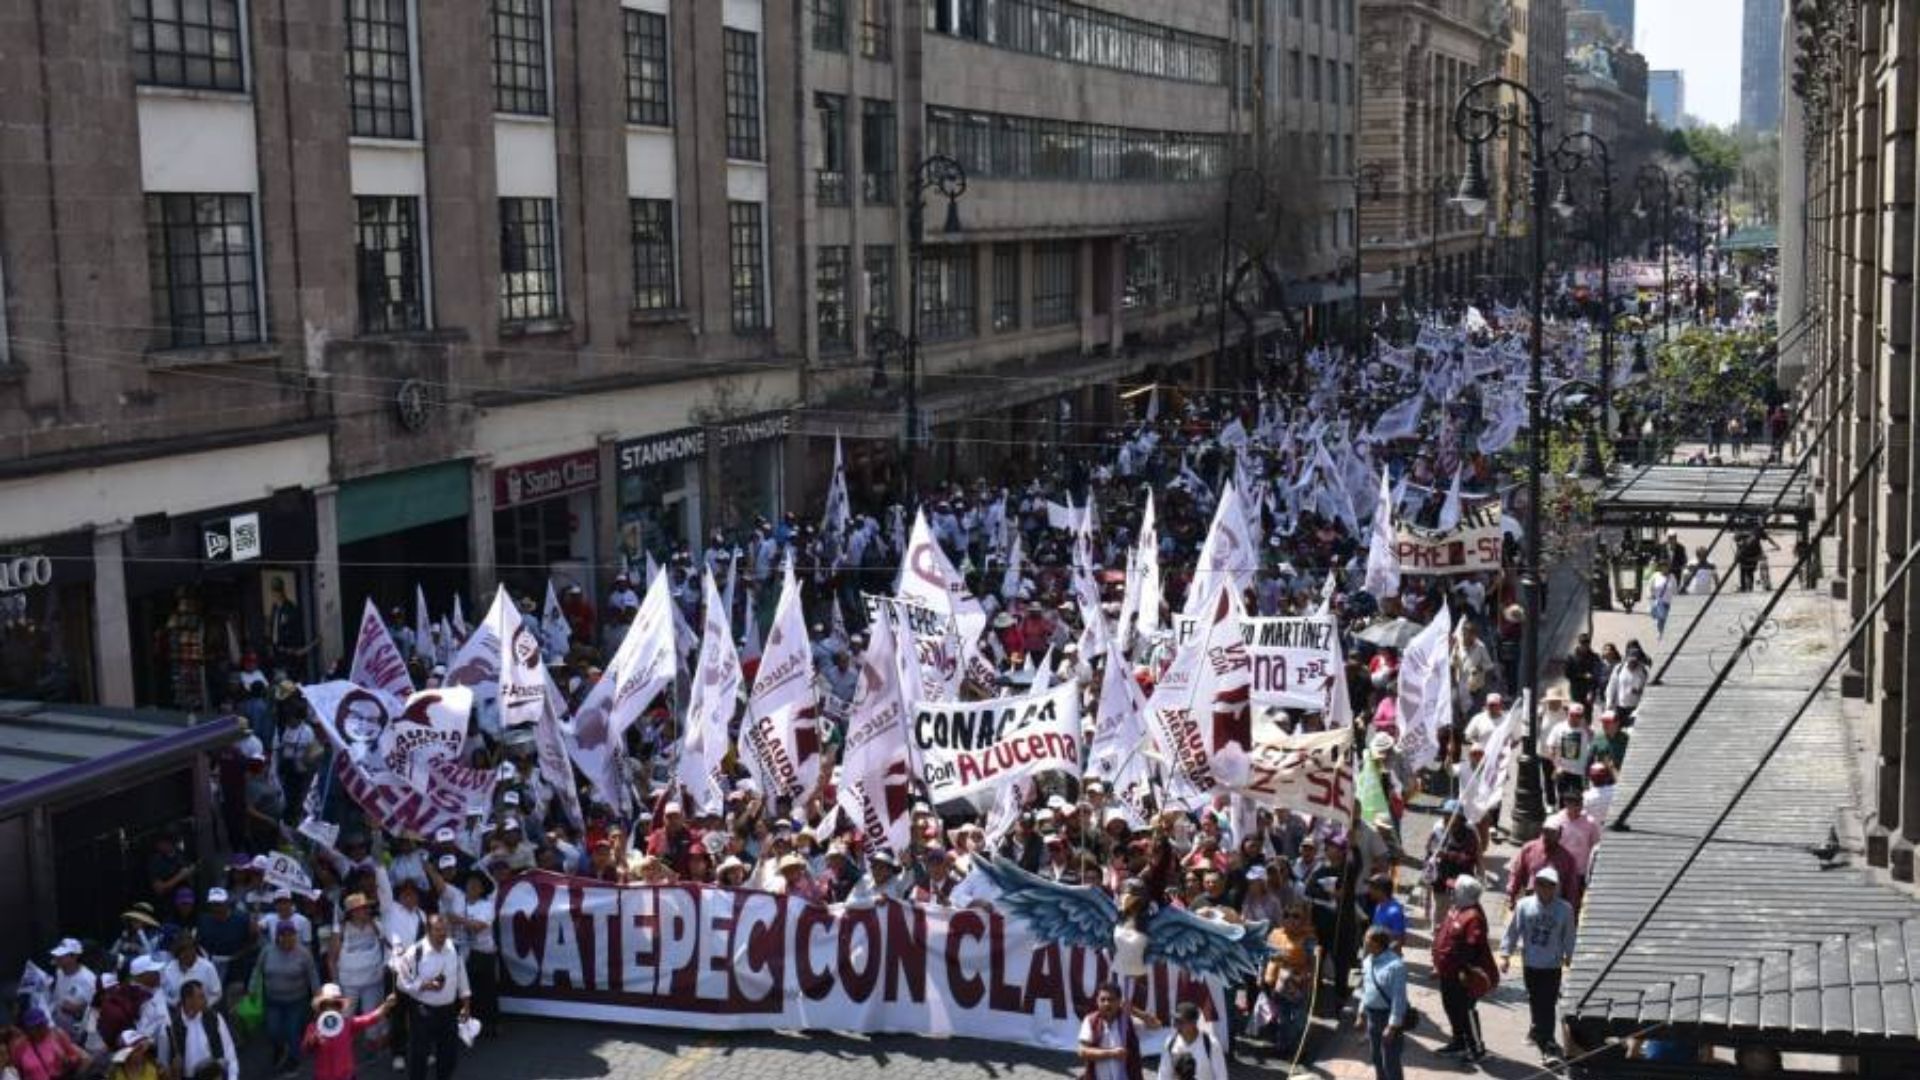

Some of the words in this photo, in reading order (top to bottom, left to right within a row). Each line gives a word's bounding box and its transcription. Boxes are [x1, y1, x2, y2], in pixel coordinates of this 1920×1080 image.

[524, 467, 560, 495] Santa
[1259, 619, 1332, 650] MARTÍNEZ
[759, 715, 805, 799] CLAUDIA
[923, 760, 956, 792] Con
[501, 882, 775, 1001] CATEPEC
[800, 903, 926, 1006] CON
